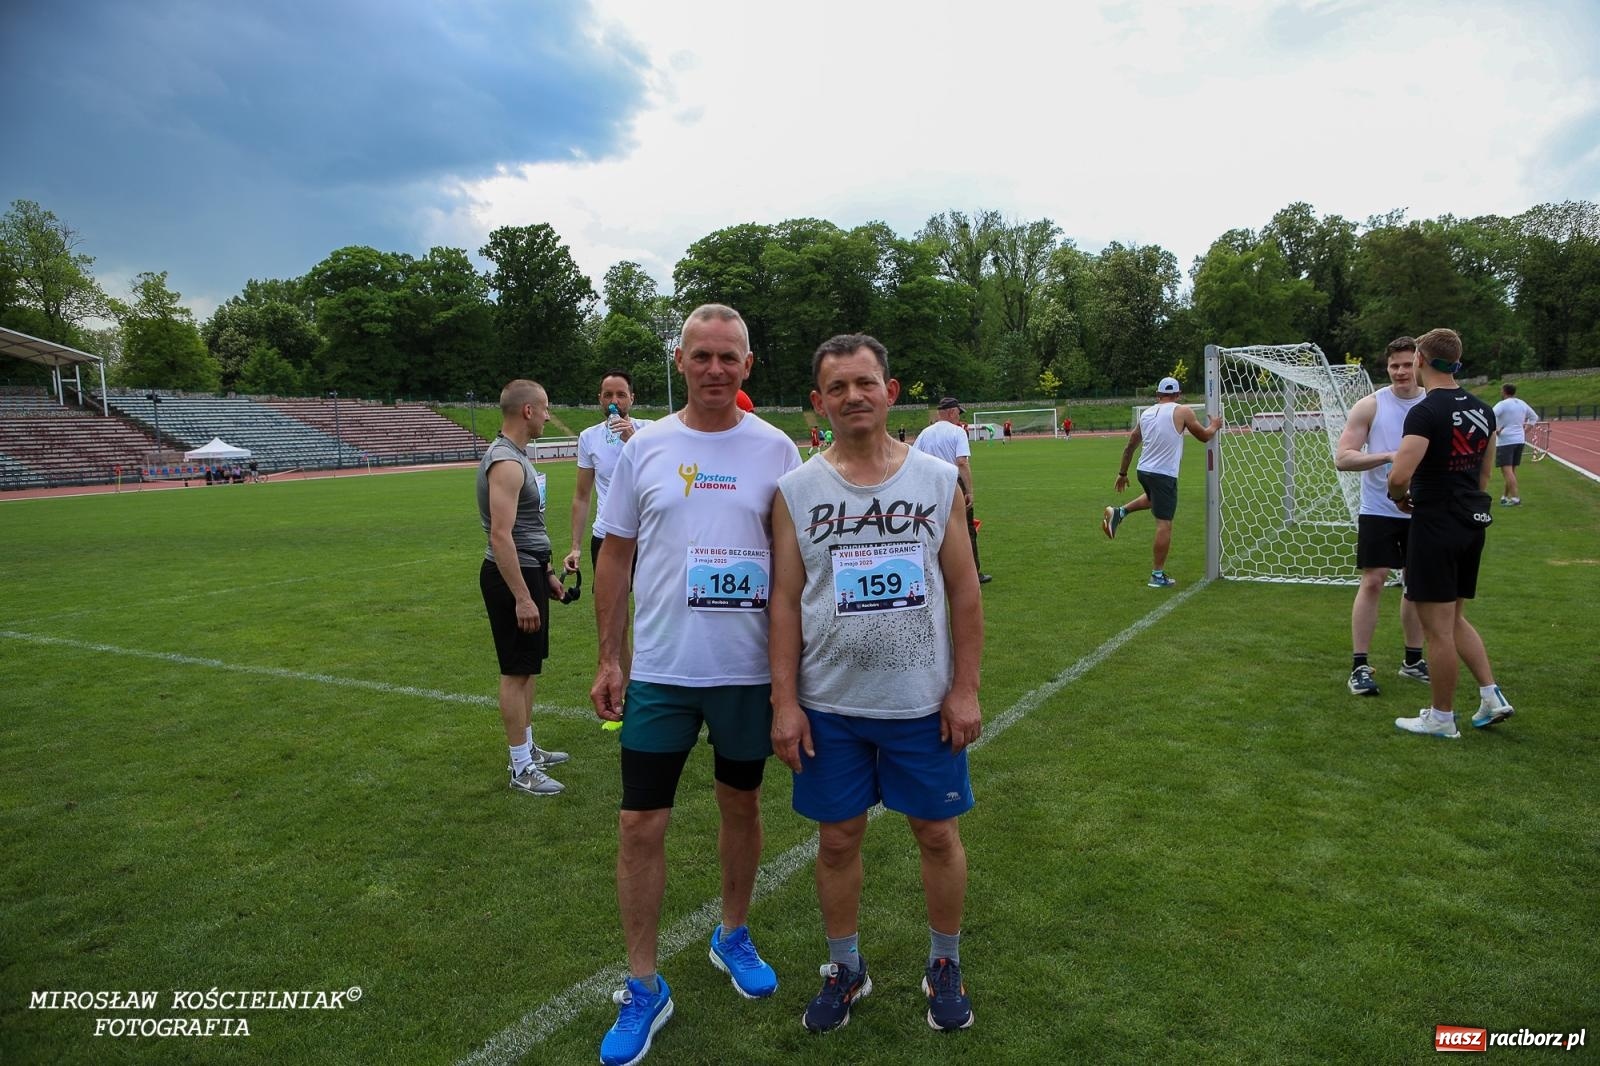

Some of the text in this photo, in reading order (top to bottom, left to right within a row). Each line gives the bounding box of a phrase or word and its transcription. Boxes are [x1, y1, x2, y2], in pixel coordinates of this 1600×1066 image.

[695, 472, 737, 483] Dystans
[694, 482, 737, 490] LUBOMIA
[808, 497, 938, 544] BLACK
[840, 550, 853, 558] XVII
[854, 549, 872, 557] BIEG
[873, 547, 887, 556] BEZ
[888, 545, 917, 554] GRANIC
[844, 560, 859, 568] maja
[710, 573, 751, 595] 184
[857, 572, 902, 597] 159
